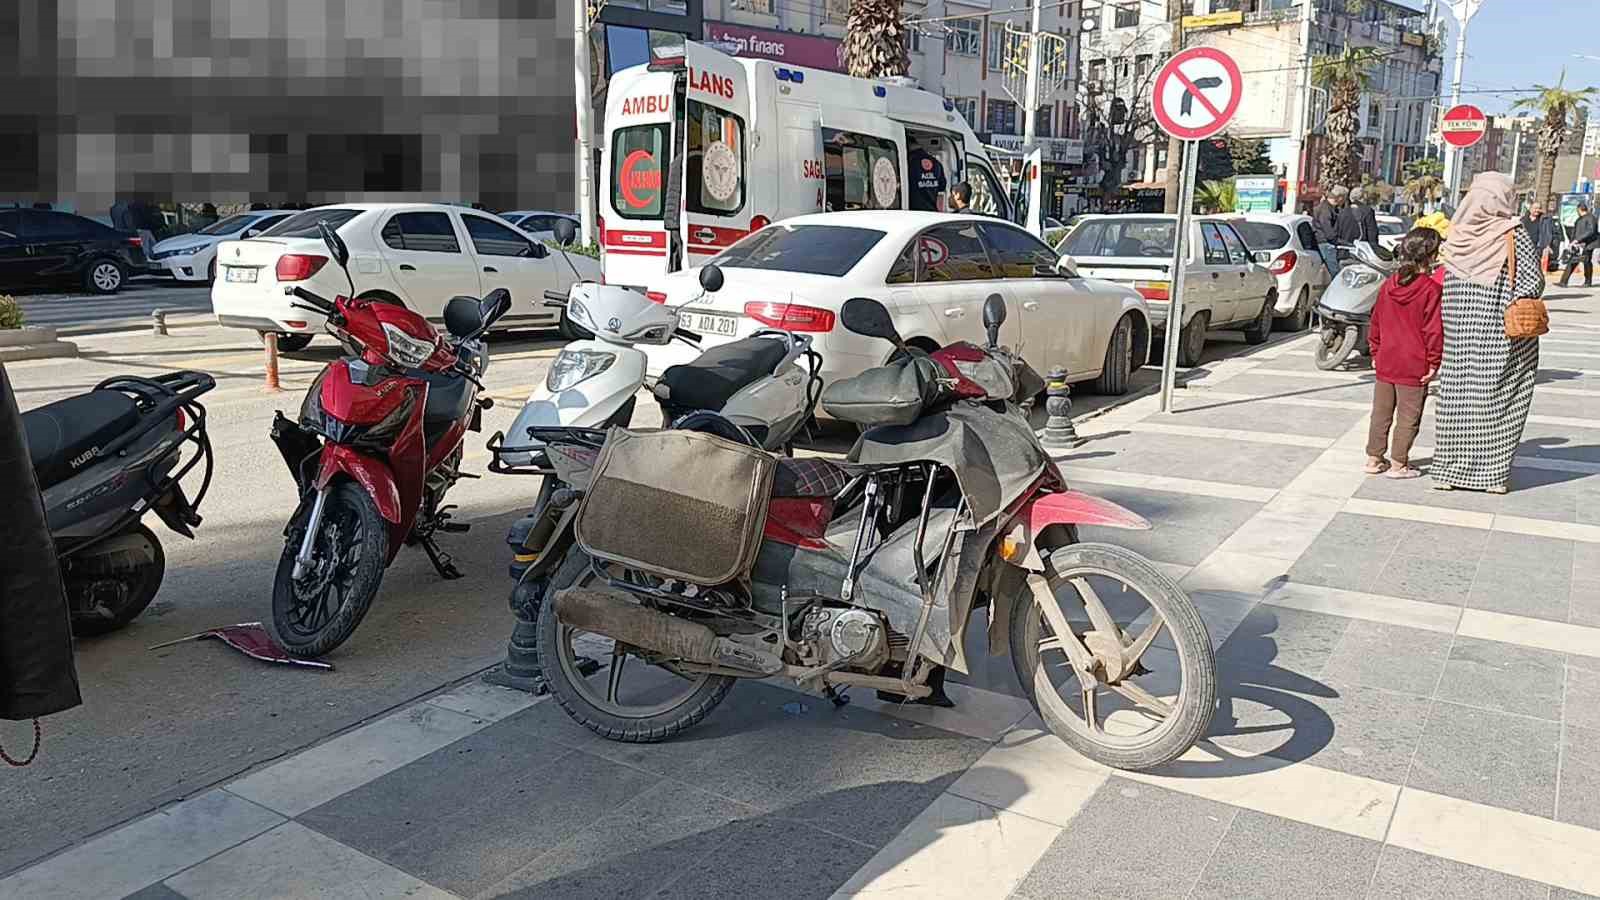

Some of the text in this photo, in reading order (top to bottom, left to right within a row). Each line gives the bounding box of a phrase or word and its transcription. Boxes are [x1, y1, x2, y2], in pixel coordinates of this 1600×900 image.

[750, 35, 784, 56] finans
[621, 95, 669, 115] AMBU
[717, 317, 735, 334] 201
